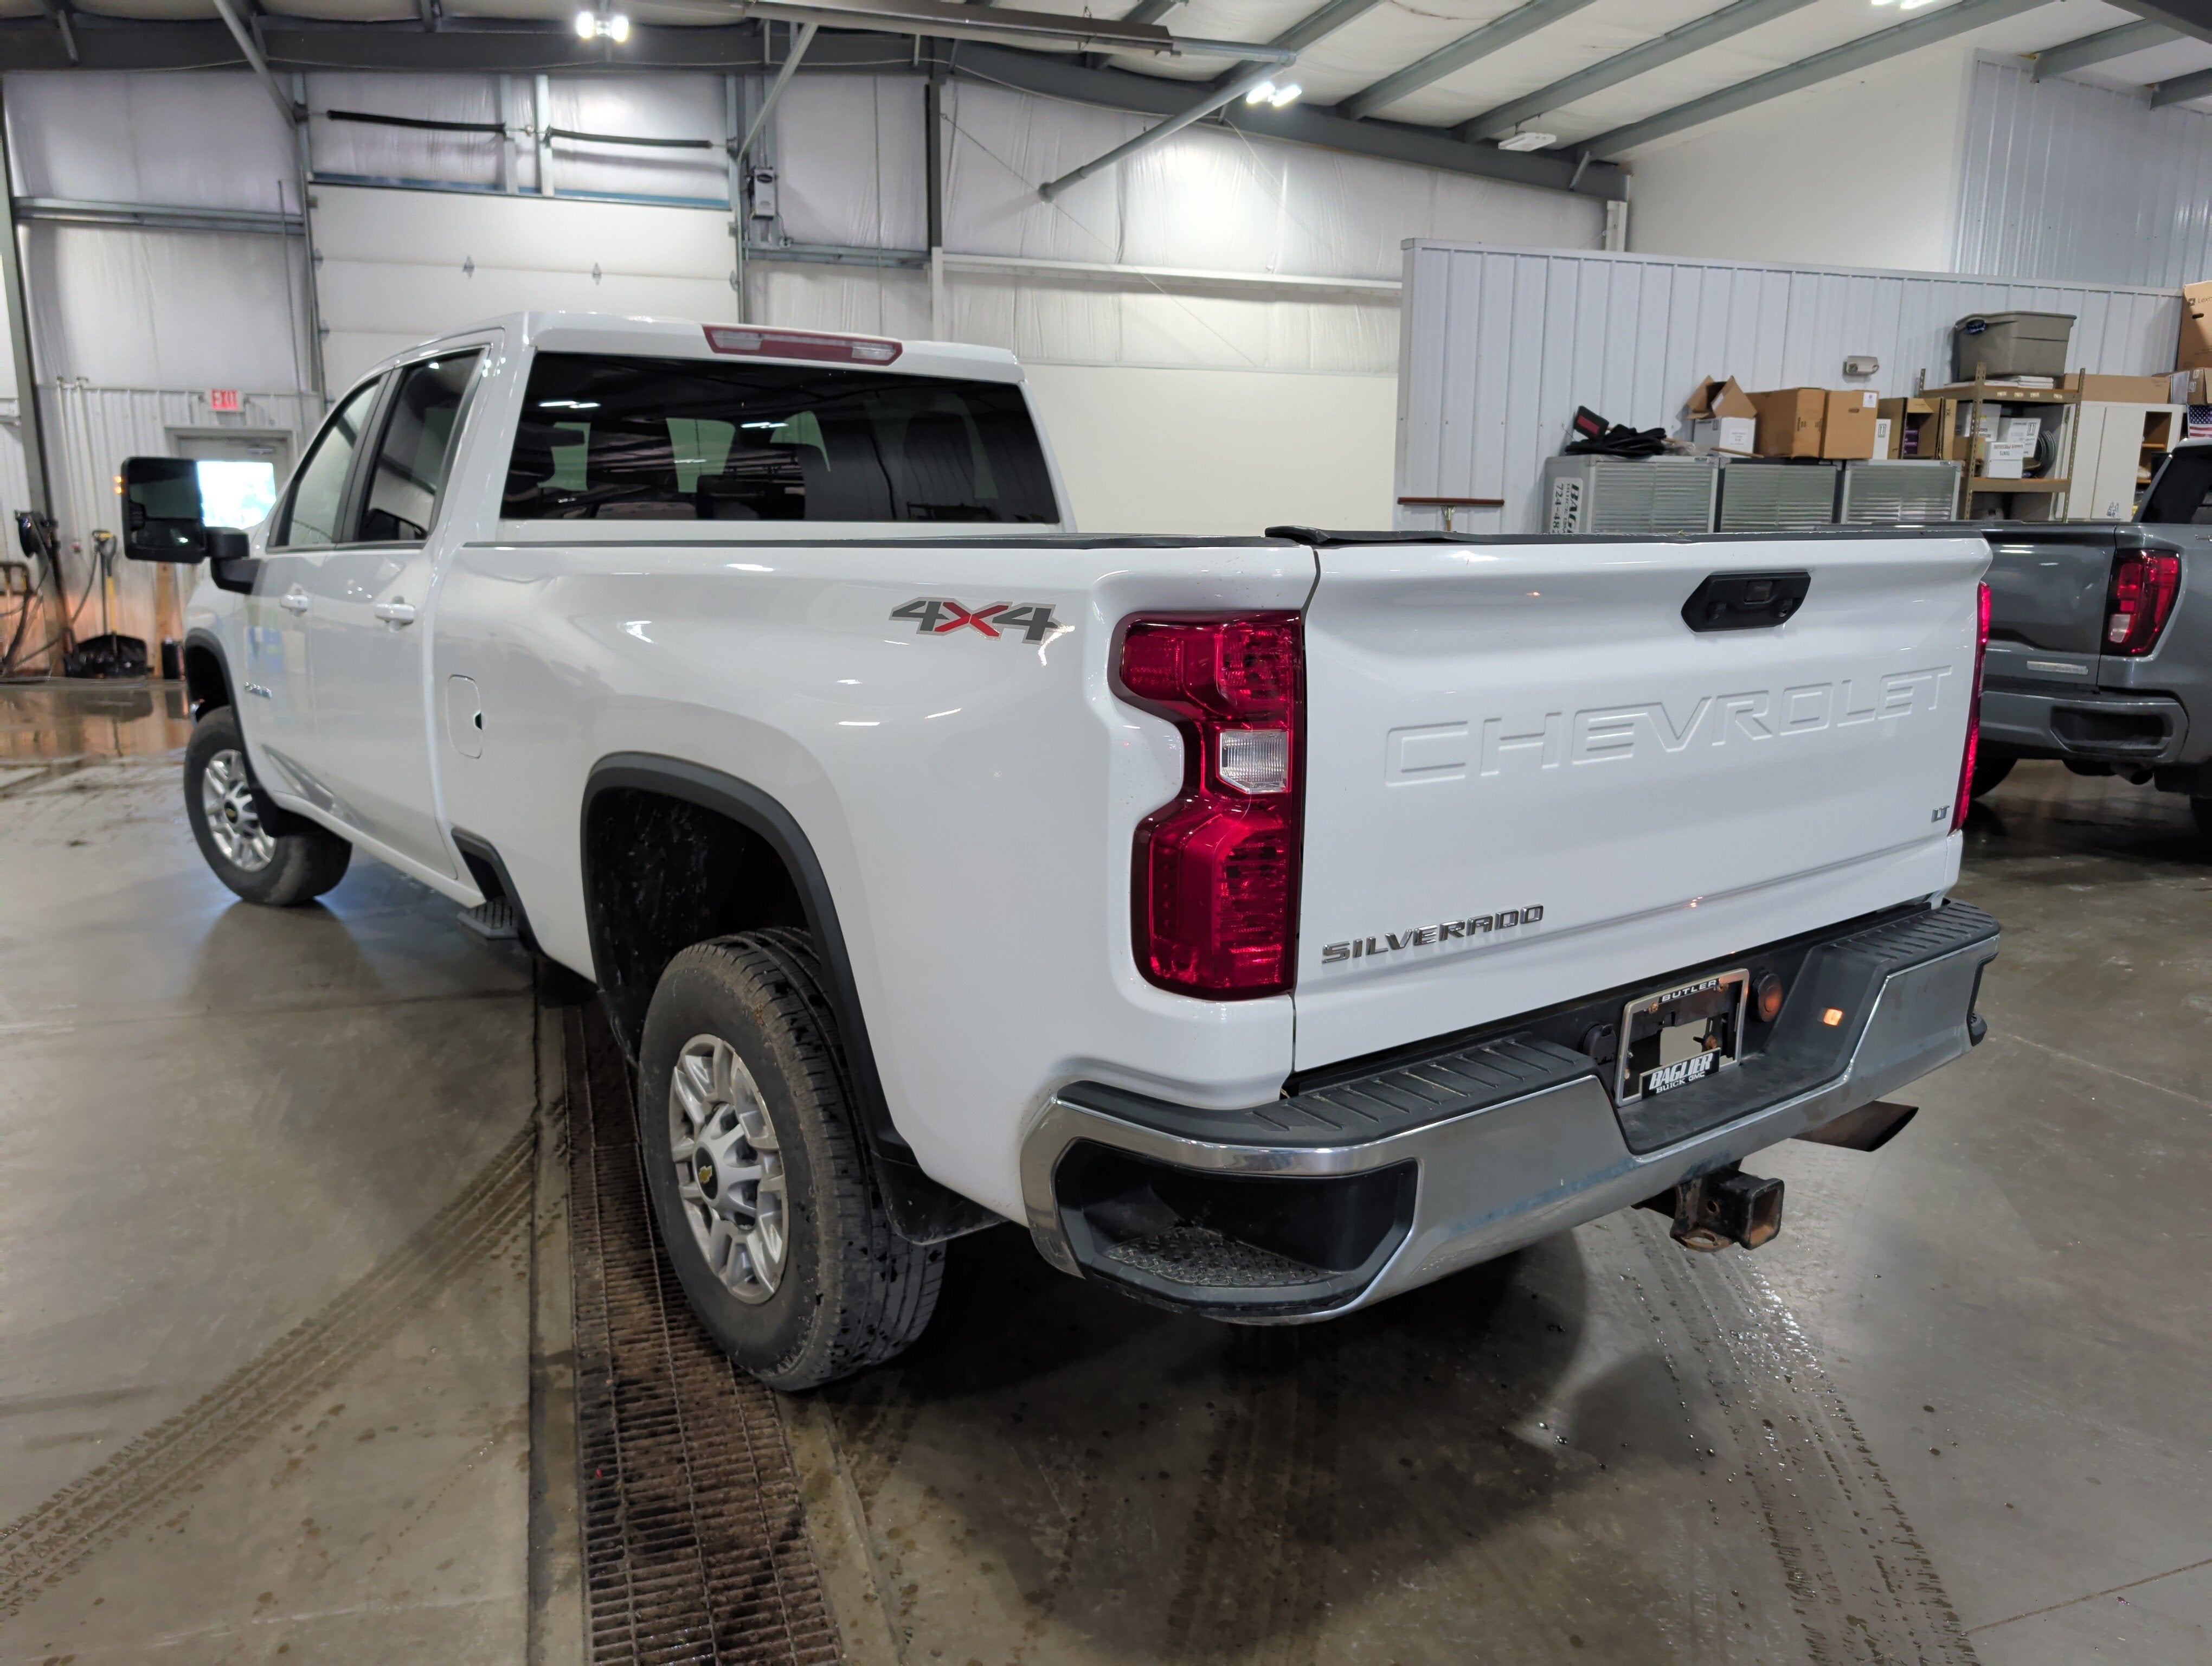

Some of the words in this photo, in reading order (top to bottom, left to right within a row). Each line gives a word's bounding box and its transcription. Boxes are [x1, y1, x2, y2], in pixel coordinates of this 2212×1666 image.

[212, 389, 237, 409] EXIT
[1385, 665, 1952, 787] CHEVROLET
[1931, 805, 1950, 823] LT
[1321, 904, 1545, 964] SILVERADO
[1662, 979, 1718, 1002] BUTLER
[1649, 1053, 1713, 1091] BAGLIER
[1656, 1078, 1687, 1094] BUICK
[1688, 1071, 1706, 1082] GMC
